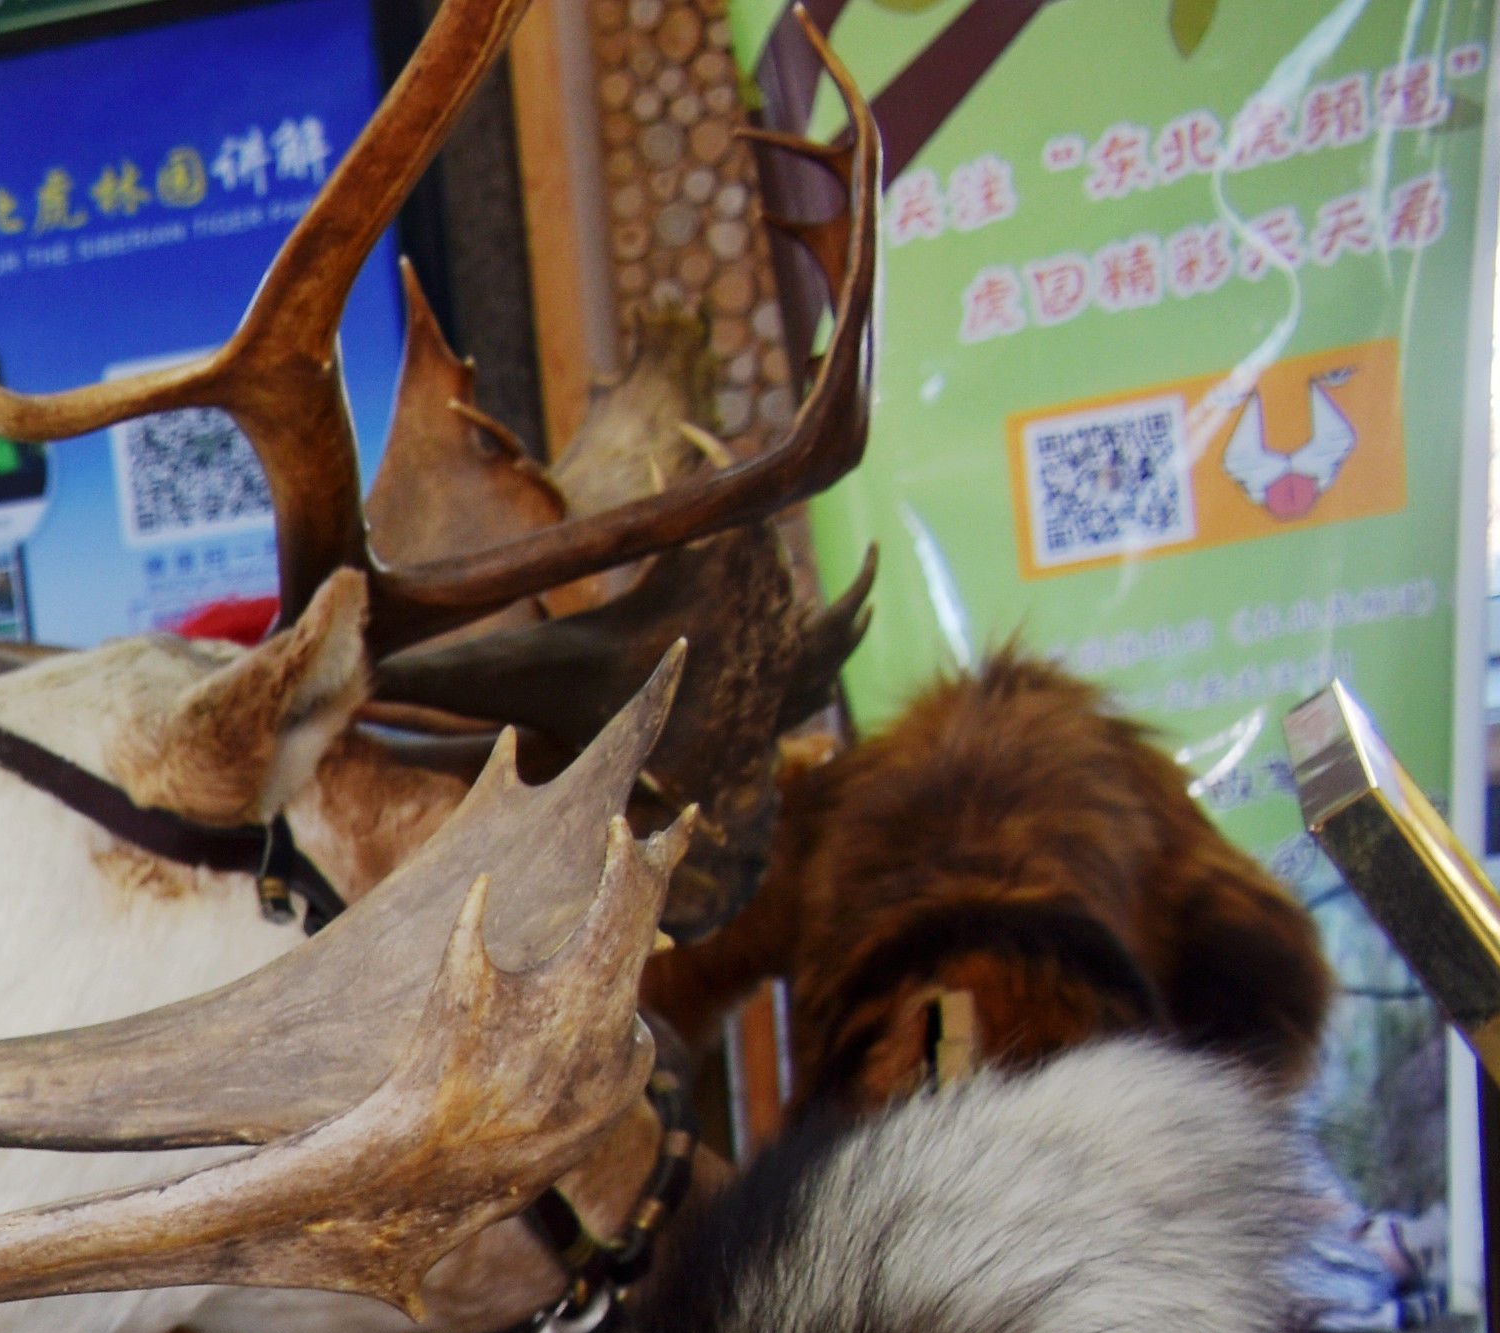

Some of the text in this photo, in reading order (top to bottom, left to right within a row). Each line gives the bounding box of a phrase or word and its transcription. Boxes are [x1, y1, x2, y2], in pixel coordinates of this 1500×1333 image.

[26, 241, 71, 268] THE
[75, 221, 188, 264] SIBERIAN
[193, 204, 264, 239] TIGER
